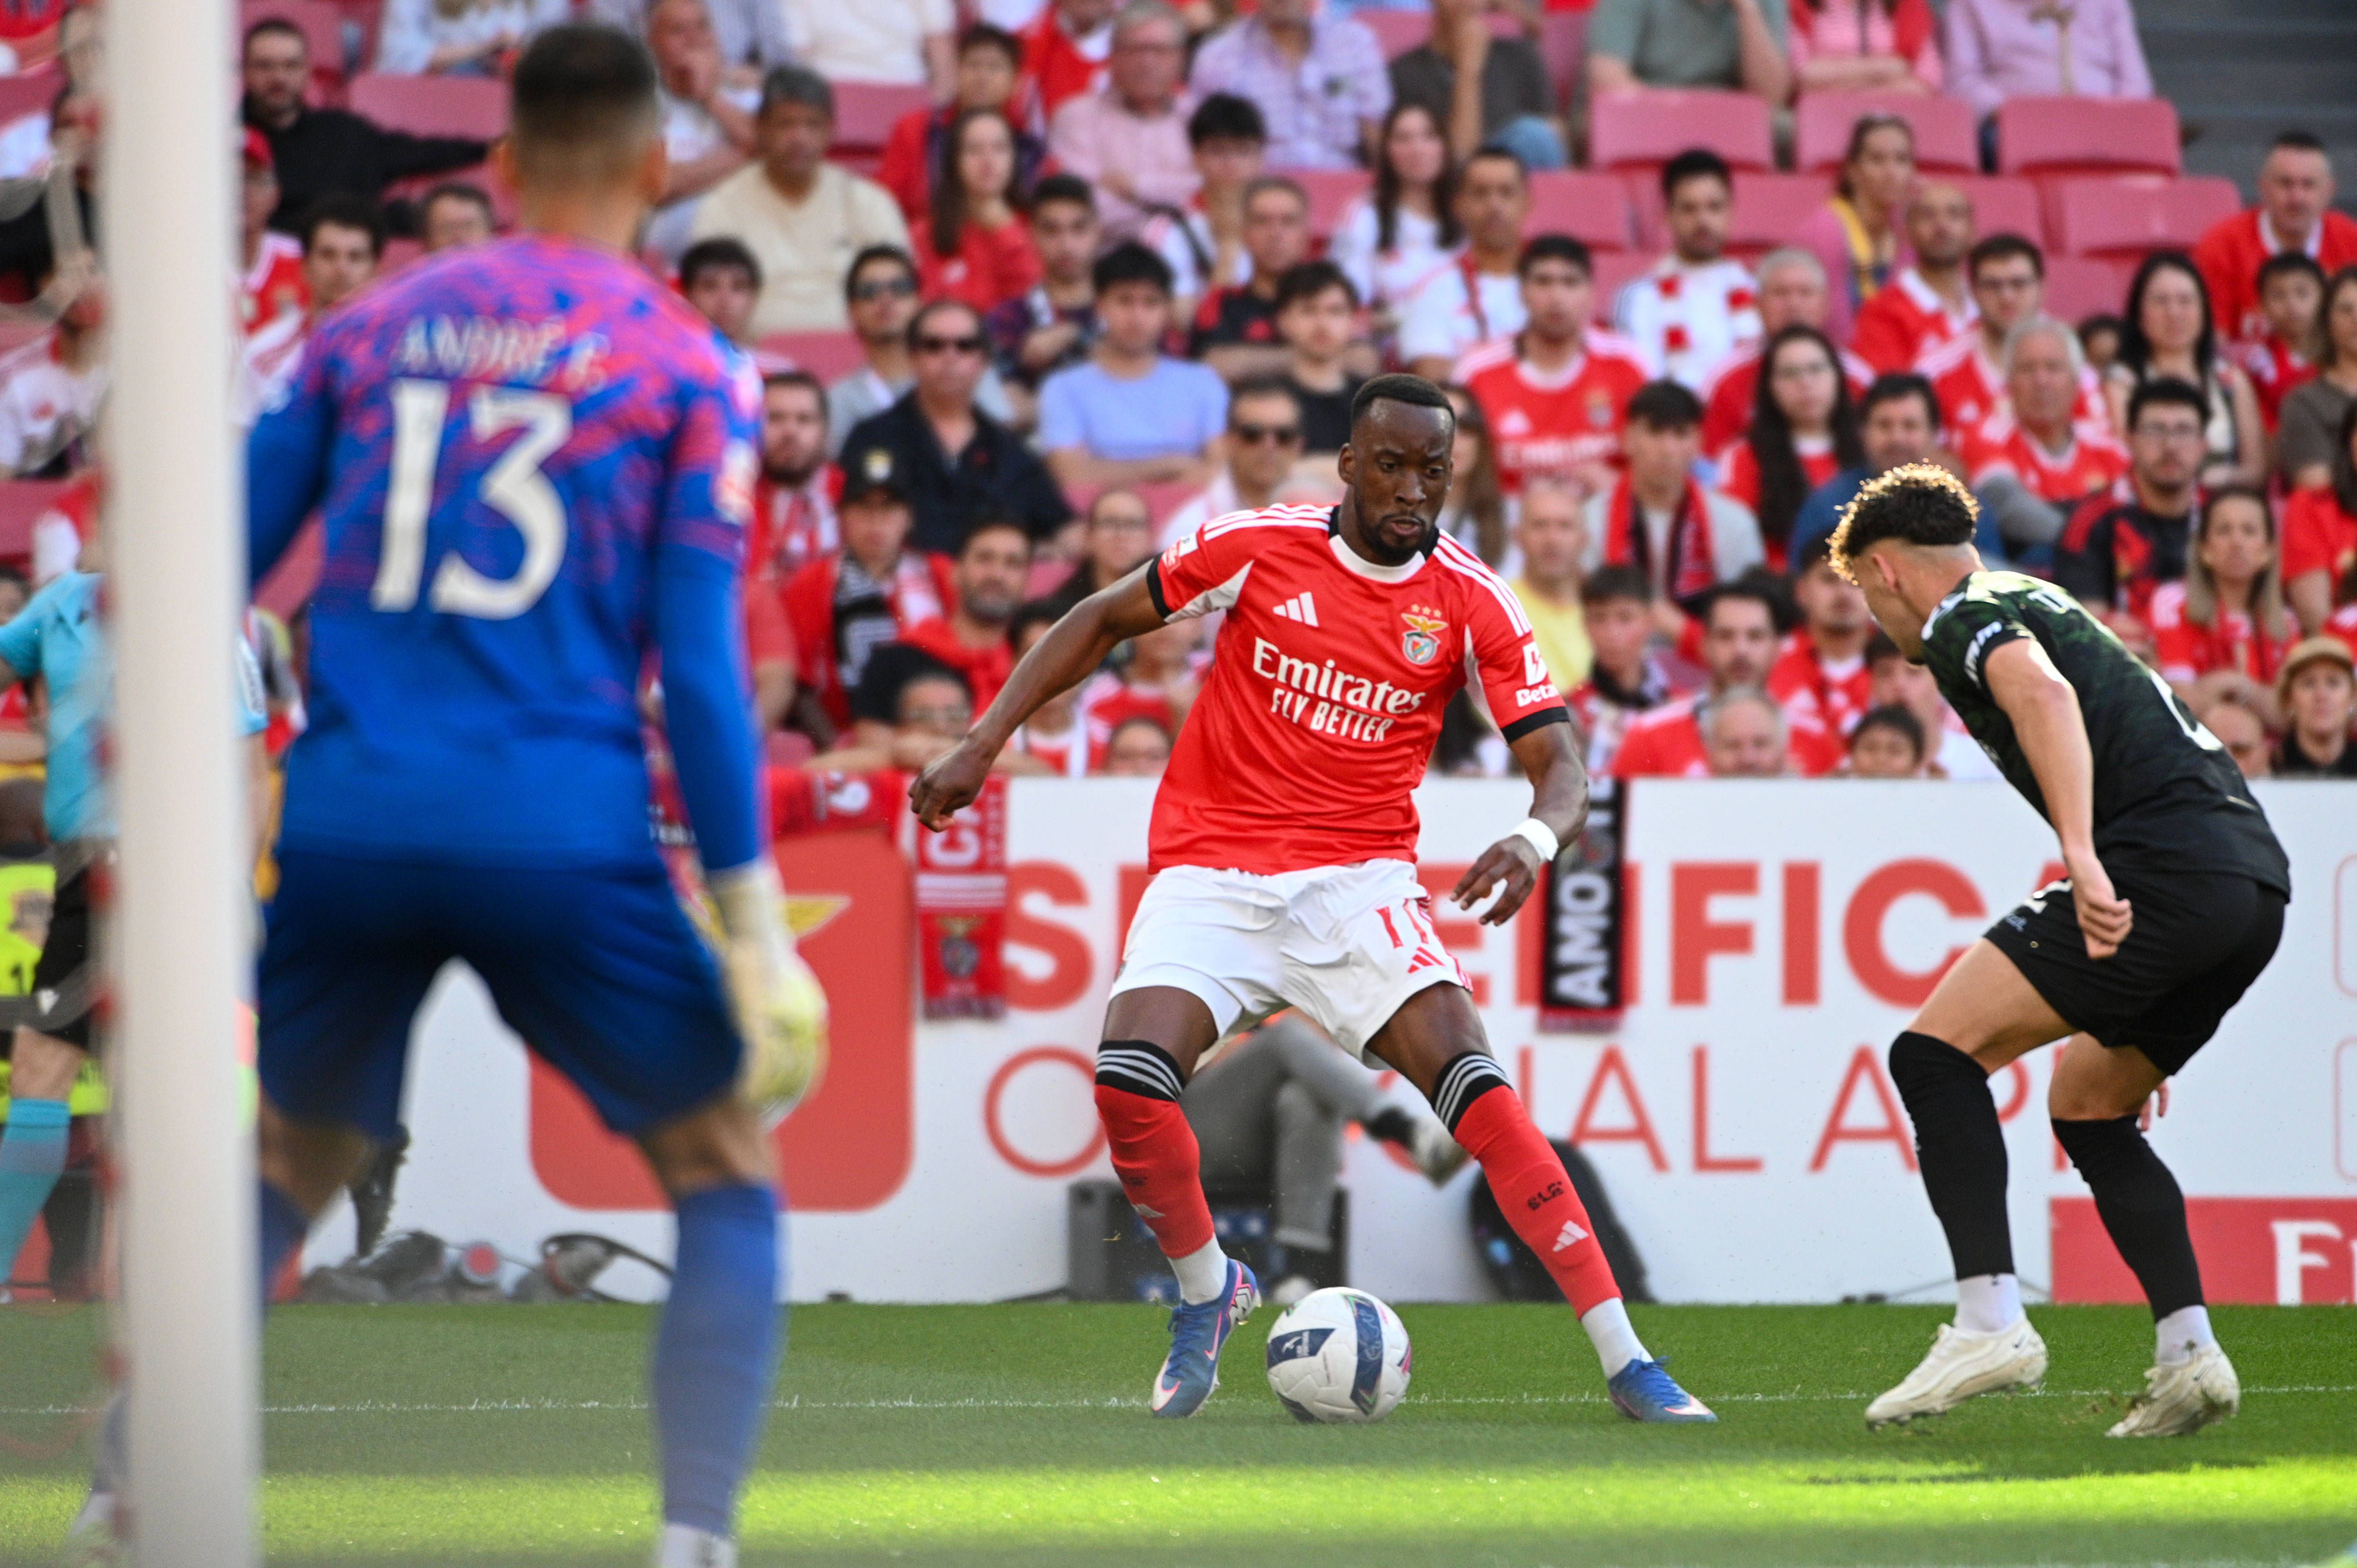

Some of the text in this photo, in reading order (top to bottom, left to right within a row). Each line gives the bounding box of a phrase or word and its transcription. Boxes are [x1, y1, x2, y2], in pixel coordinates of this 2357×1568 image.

[369, 378, 573, 621] 13
[1253, 636, 1427, 714] Emirates
[1270, 688, 1395, 742] FLY BETTER
[1375, 898, 1429, 949] 11
